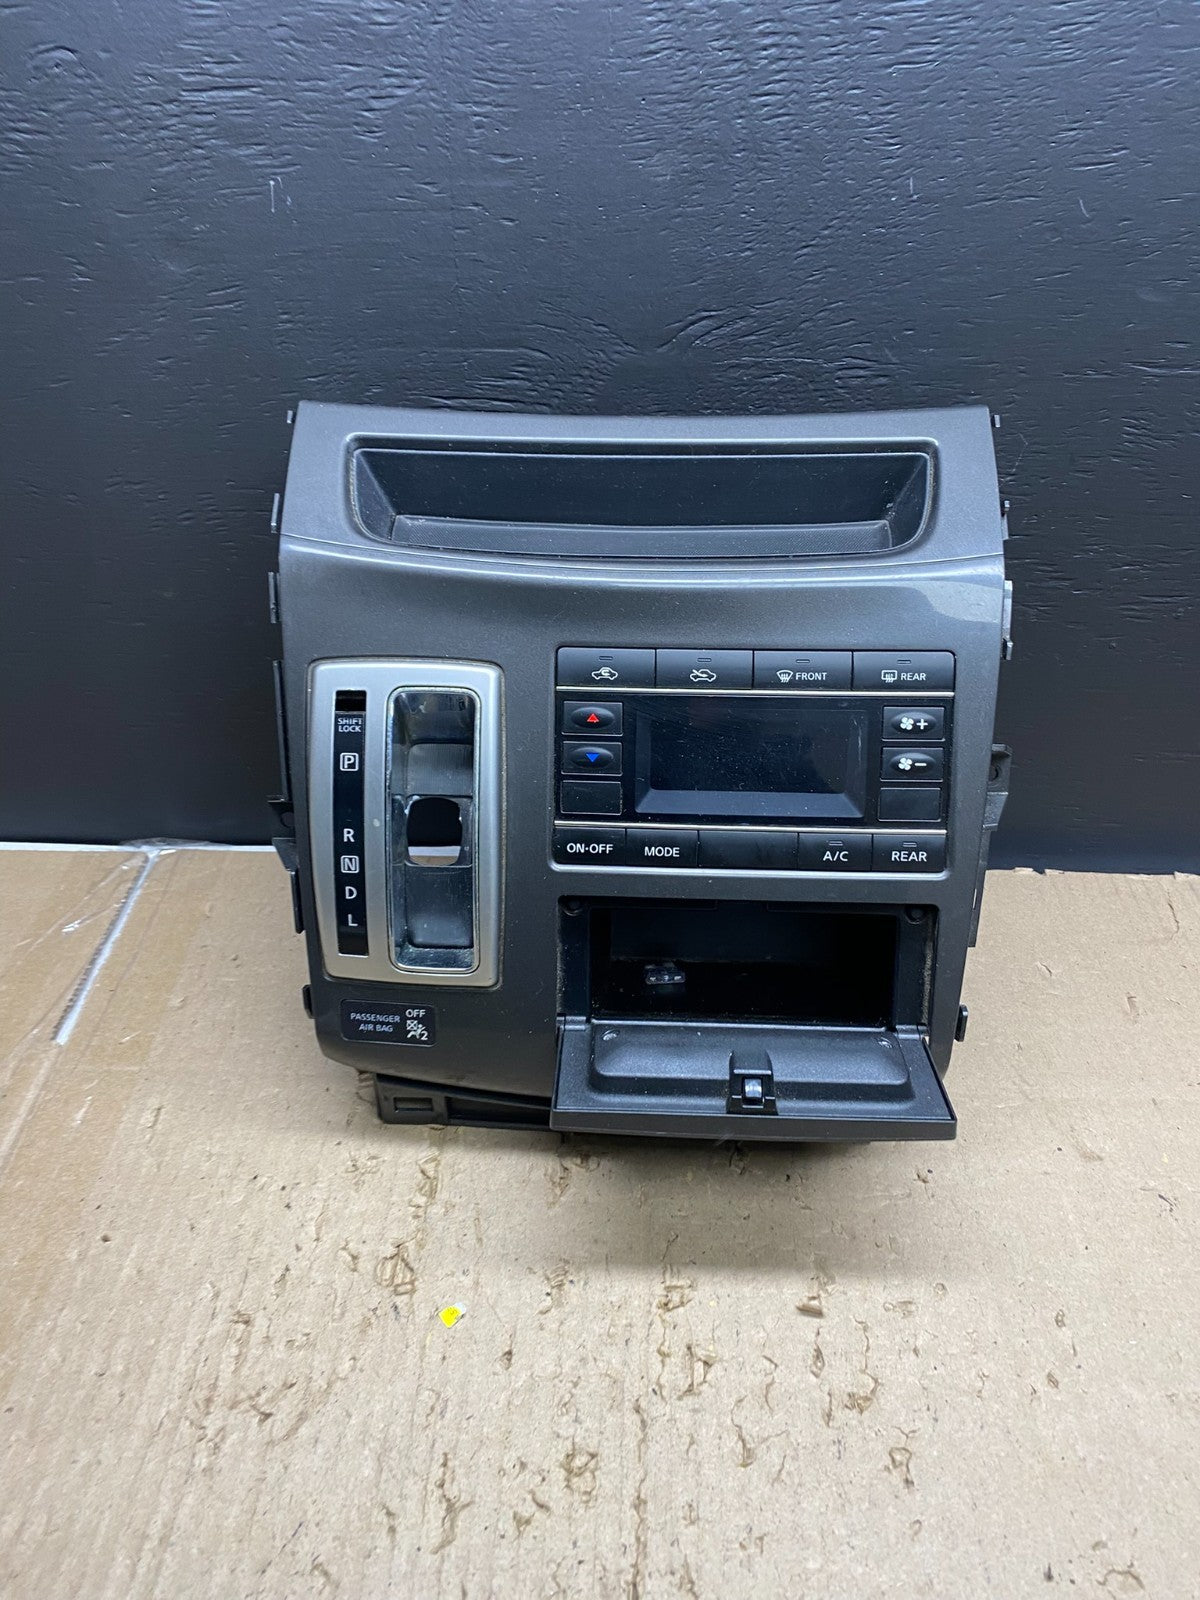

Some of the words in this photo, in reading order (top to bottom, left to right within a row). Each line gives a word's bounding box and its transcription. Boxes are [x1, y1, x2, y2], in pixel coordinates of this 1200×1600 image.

[795, 672, 827, 681] FRONT
[900, 672, 926, 681] REAR
[337, 717, 362, 725] SHIFT
[338, 725, 362, 733] LOCK
[344, 755, 355, 769] P
[343, 828, 355, 843] R
[644, 846, 680, 857] MODE
[822, 851, 849, 862] A/C
[891, 851, 927, 862] REAR
[344, 857, 356, 871] N
[345, 886, 357, 900] D
[348, 914, 358, 927] L
[350, 1012, 400, 1022] PASSENGER
[405, 1009, 425, 1018] OFF
[359, 1023, 374, 1031] AIR
[375, 1024, 393, 1032] BAG
